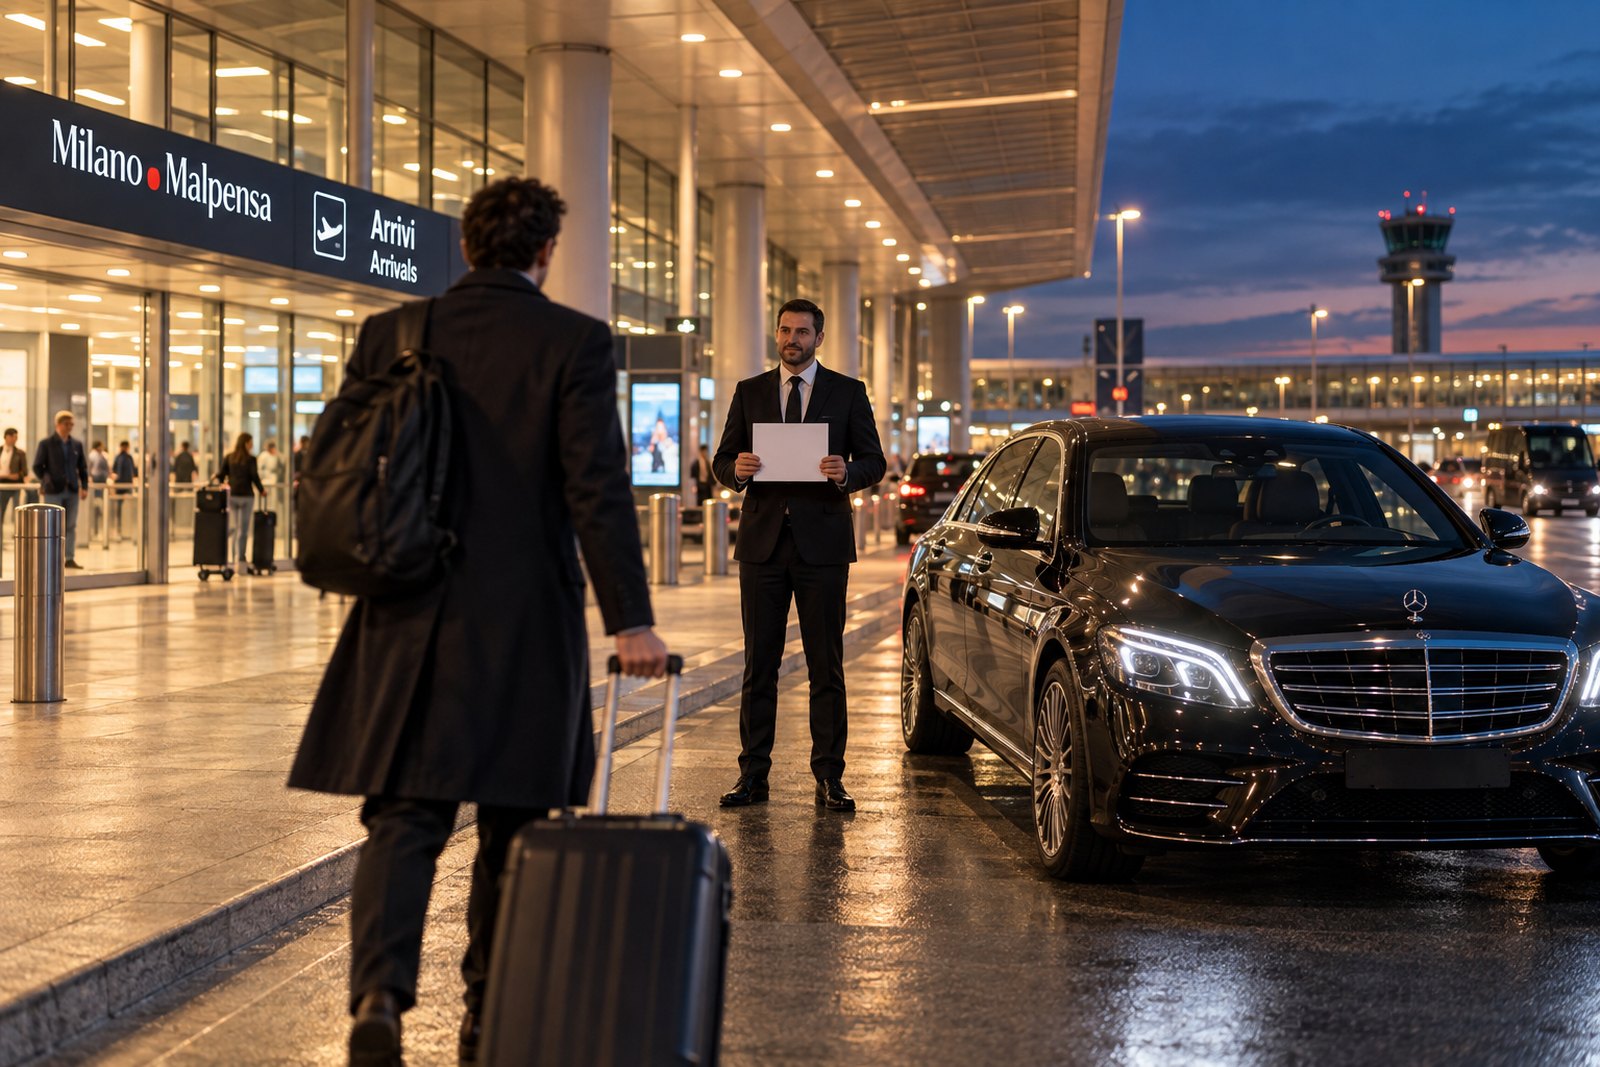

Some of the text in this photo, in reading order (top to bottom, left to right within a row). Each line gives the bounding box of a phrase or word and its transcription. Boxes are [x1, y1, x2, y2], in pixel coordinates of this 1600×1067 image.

[52, 118, 272, 222] Milano Malpensa
[370, 209, 415, 250] Arrivi
[369, 249, 418, 283] Arrivals
